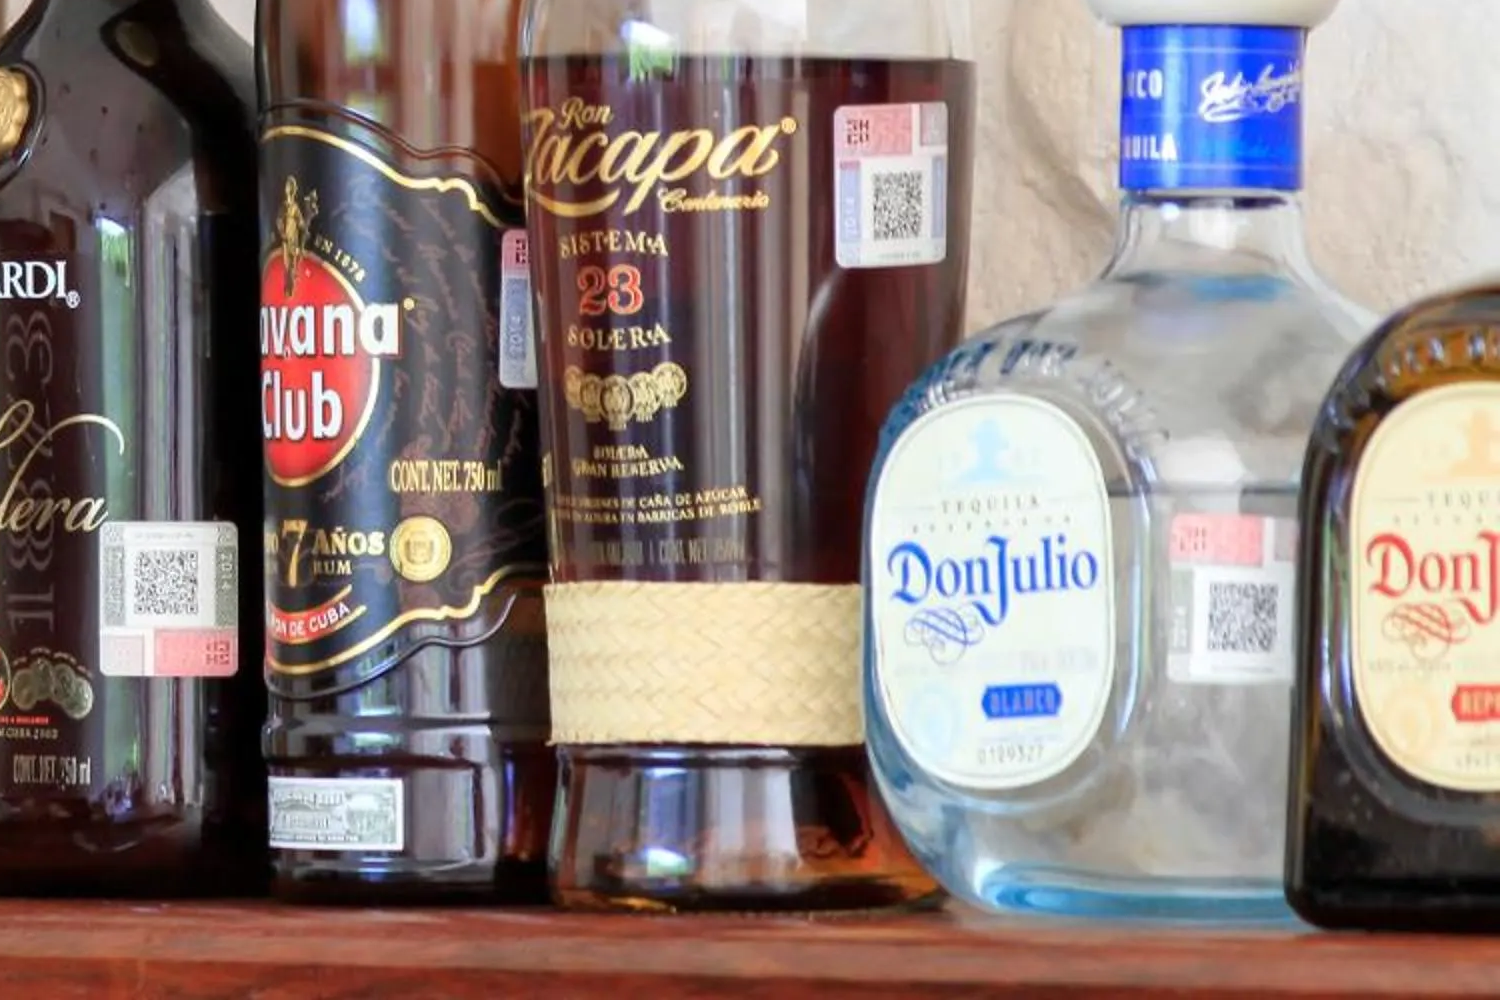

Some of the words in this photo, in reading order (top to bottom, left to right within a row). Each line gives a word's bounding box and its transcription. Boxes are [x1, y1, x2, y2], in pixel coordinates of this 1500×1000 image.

[559, 97, 614, 130] Ron
[559, 229, 669, 259] SISTEMA
[577, 263, 645, 316] 23
[567, 322, 672, 350] SOLERA
[463, 460, 485, 493] 750
[611, 455, 685, 478] RESERVA
[639, 494, 673, 509] CAÑA
[637, 509, 695, 525] BARRICAS
[281, 519, 308, 588] 7
[312, 526, 385, 556] AÑOS
[313, 559, 353, 576] RUM
[309, 602, 350, 633] CUBA
